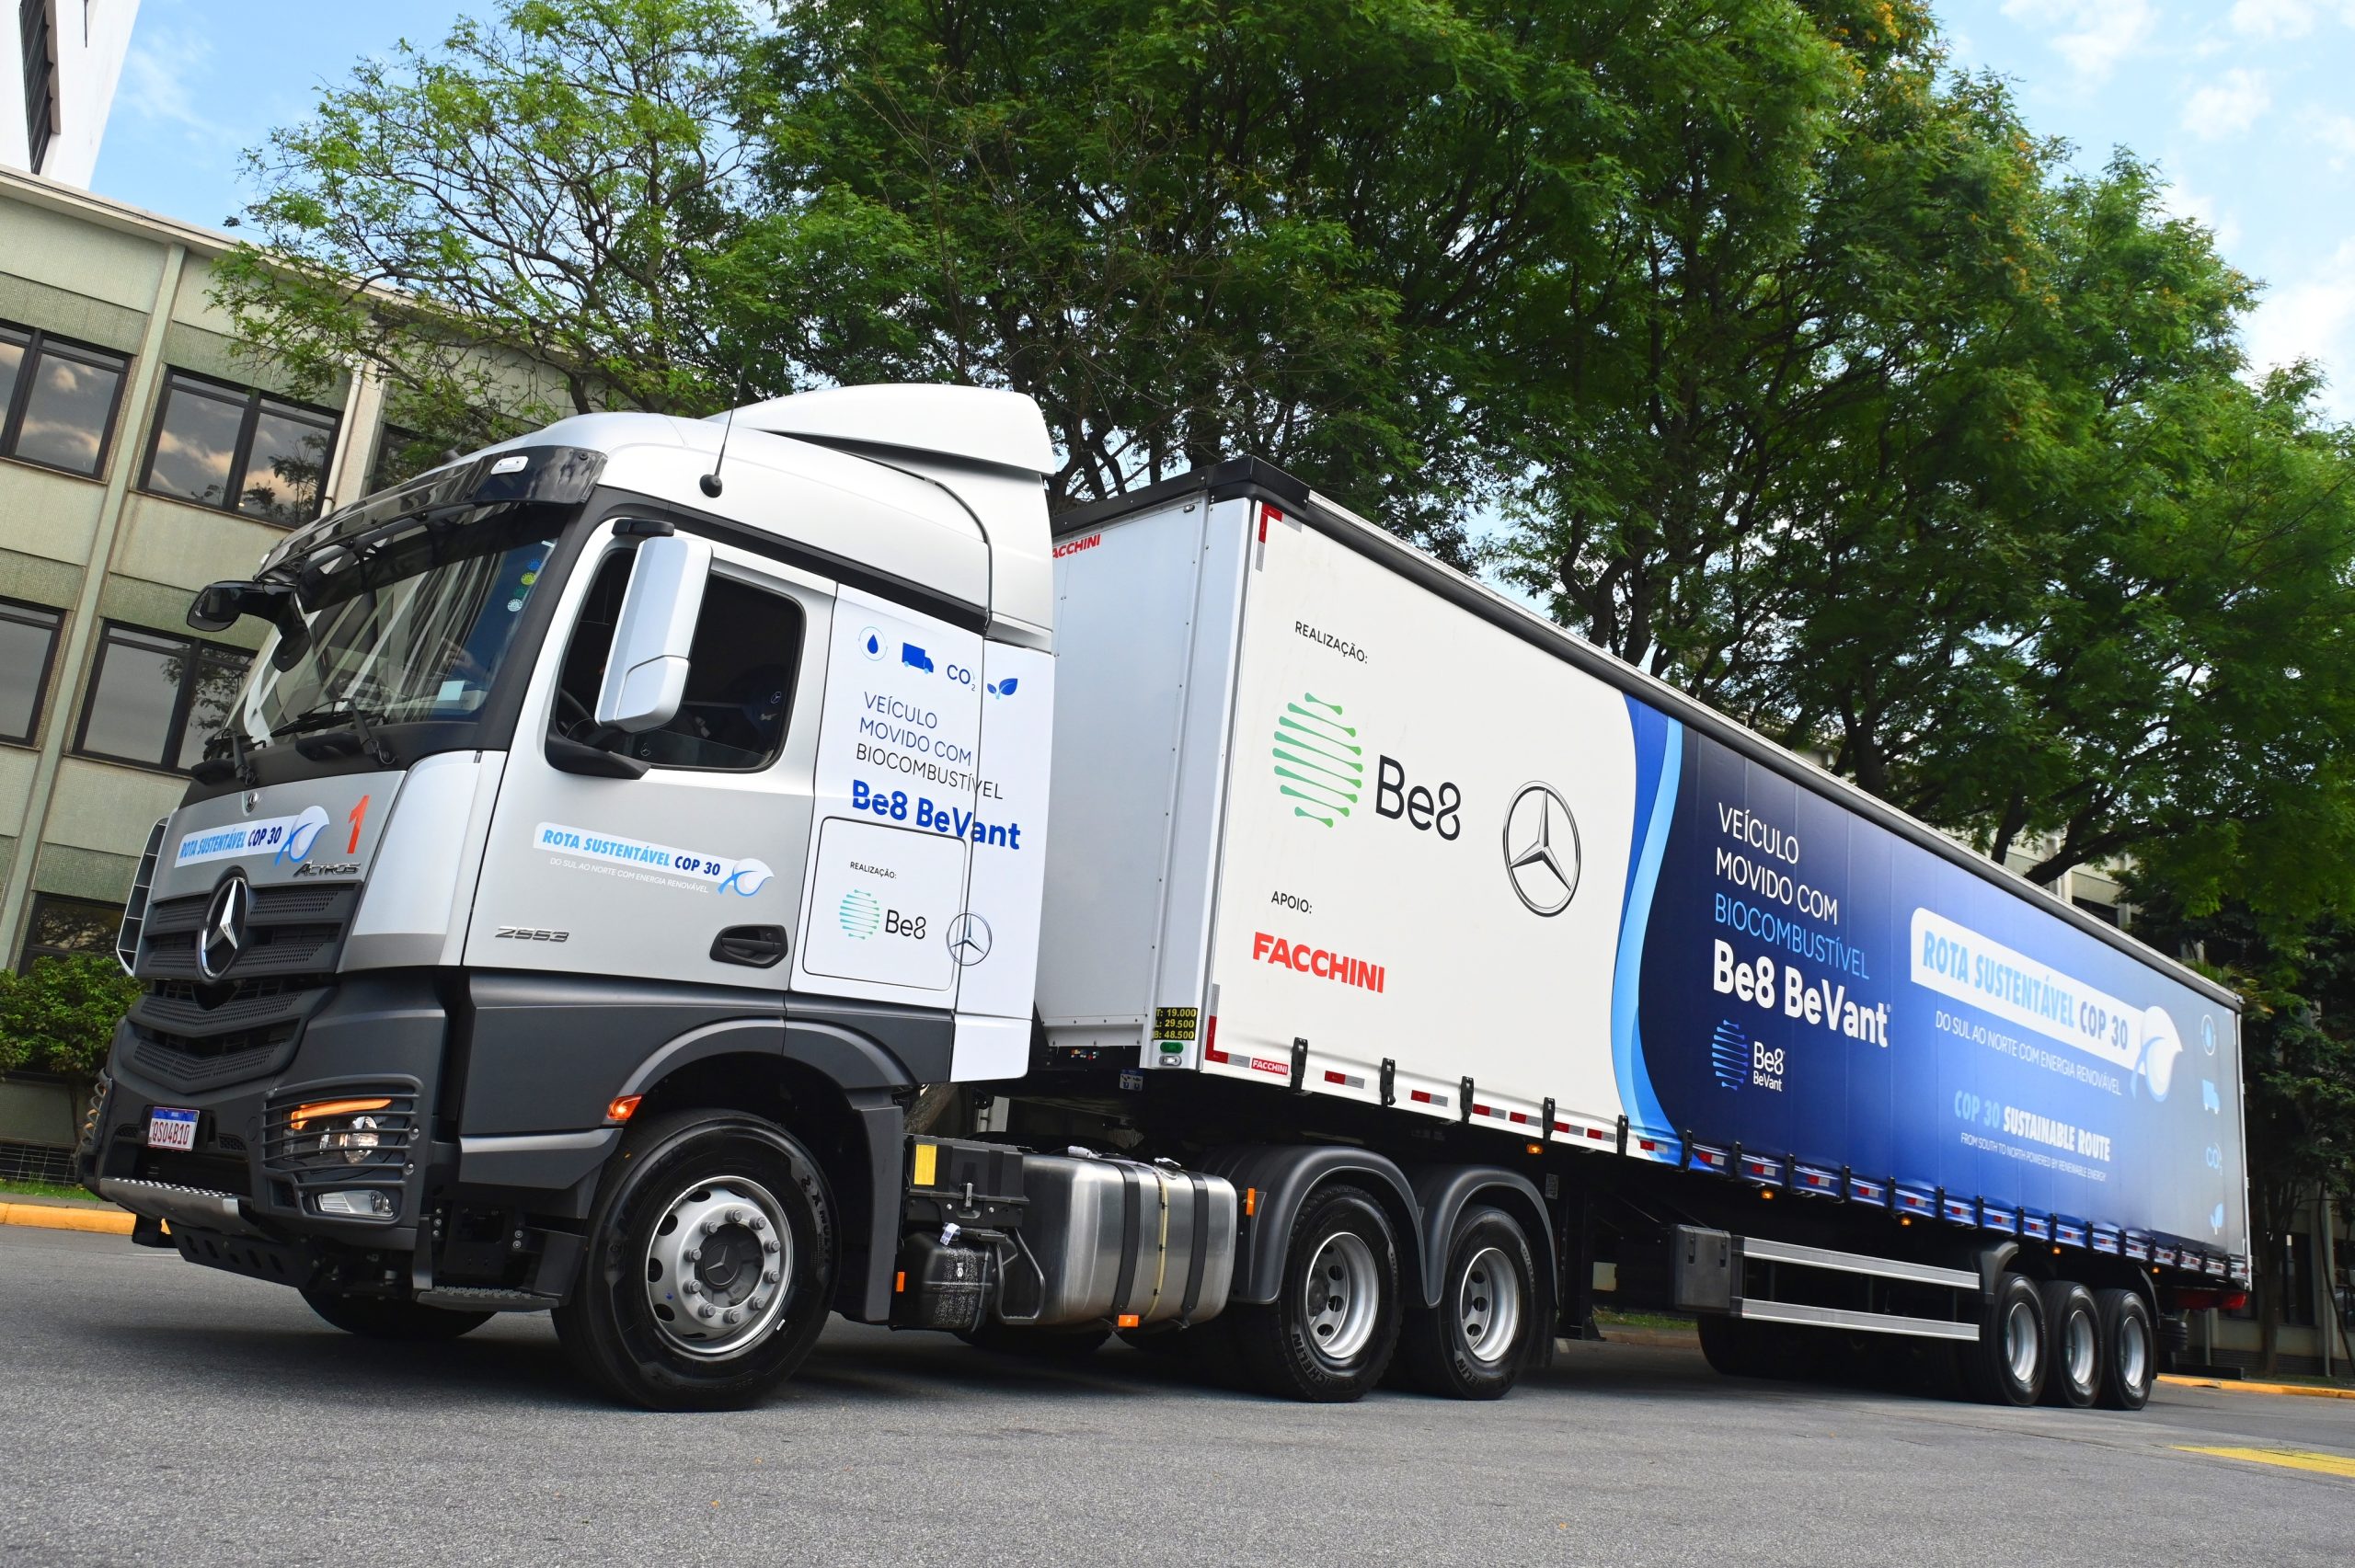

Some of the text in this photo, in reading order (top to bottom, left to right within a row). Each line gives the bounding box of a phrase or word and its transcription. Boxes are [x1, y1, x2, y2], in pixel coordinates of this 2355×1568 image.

[1052, 533, 1101, 559] ACCHINI
[1294, 620, 1368, 664] REALIZAÇÃO:
[865, 691, 937, 729] VEÍCULO
[859, 716, 971, 767] MOVIDO COM
[856, 742, 1004, 800] BIOCOMBUSTÍVEL
[852, 779, 1021, 850] Be8 BeVant
[1375, 754, 1462, 841] Be8
[179, 826, 282, 859] ROTA SUSTENTÁVEL COP 30
[347, 795, 370, 854] 1
[1718, 802, 1799, 864] VEÍCULO
[542, 829, 720, 876] ROTA SUSTENTÁVEL COP 30
[850, 862, 897, 879] REALIZAÇÃO:
[563, 859, 578, 869] SUL
[579, 863, 591, 871] AO
[592, 864, 617, 876] NORTE
[617, 870, 637, 879] COM
[636, 873, 666, 886] ENERGIA
[667, 879, 709, 894] RENOVÁVEL
[1717, 846, 1838, 926] MOVIDO COM
[885, 909, 926, 940] Be8
[1270, 890, 1313, 914] APOIO:
[495, 926, 569, 943] 2553
[1715, 892, 1870, 980] BIOCOMBUSTÍVEL
[1252, 931, 1385, 994] FACCHINI
[1713, 938, 1775, 1009] Be8
[1166, 1008, 1197, 1017] 19.000
[1923, 930, 2128, 1051] ROTA SUSTENTÁVEL COP 30
[1164, 1030, 1195, 1040] 48.500
[1165, 1019, 1195, 1029] 29.500
[1252, 1059, 1288, 1074] FACCHINI
[1936, 1011, 2122, 1095] DO SUL AO NORTE COM ENERGIA RENOVÁVEL
[1753, 1070, 1783, 1092] BeVant
[1954, 1090, 2110, 1162] COP 30 SUSTAINABLE ROUTE
